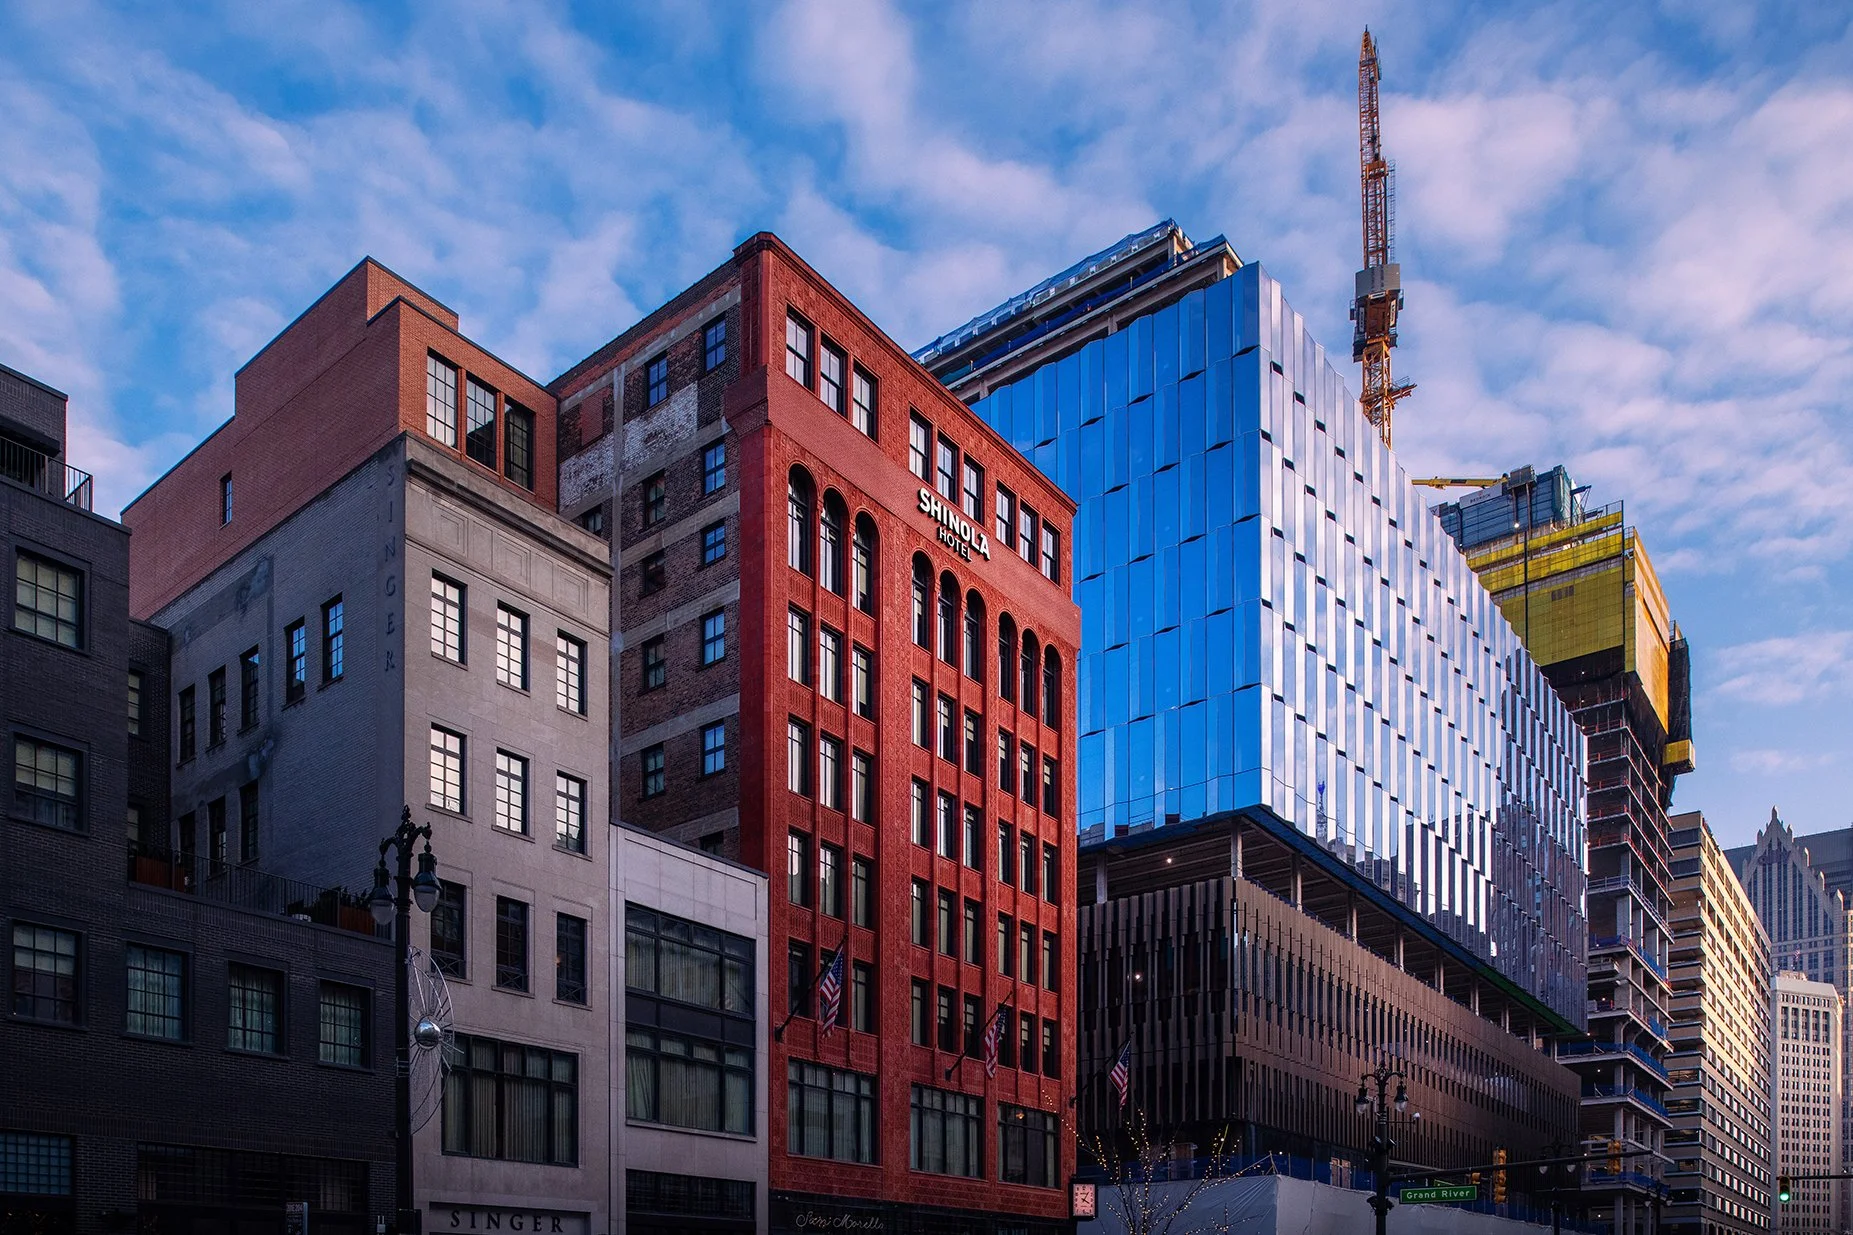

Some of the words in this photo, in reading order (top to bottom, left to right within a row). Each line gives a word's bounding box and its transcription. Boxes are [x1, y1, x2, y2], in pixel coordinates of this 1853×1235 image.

[918, 487, 991, 561] SHINOLA
[938, 526, 973, 562] HOTEL
[384, 463, 396, 673] SINGER
[1406, 1190, 1436, 1200] Grand
[1441, 1189, 1471, 1199] River
[450, 1210, 564, 1233] SINGER
[832, 1213, 885, 1230] Morello
